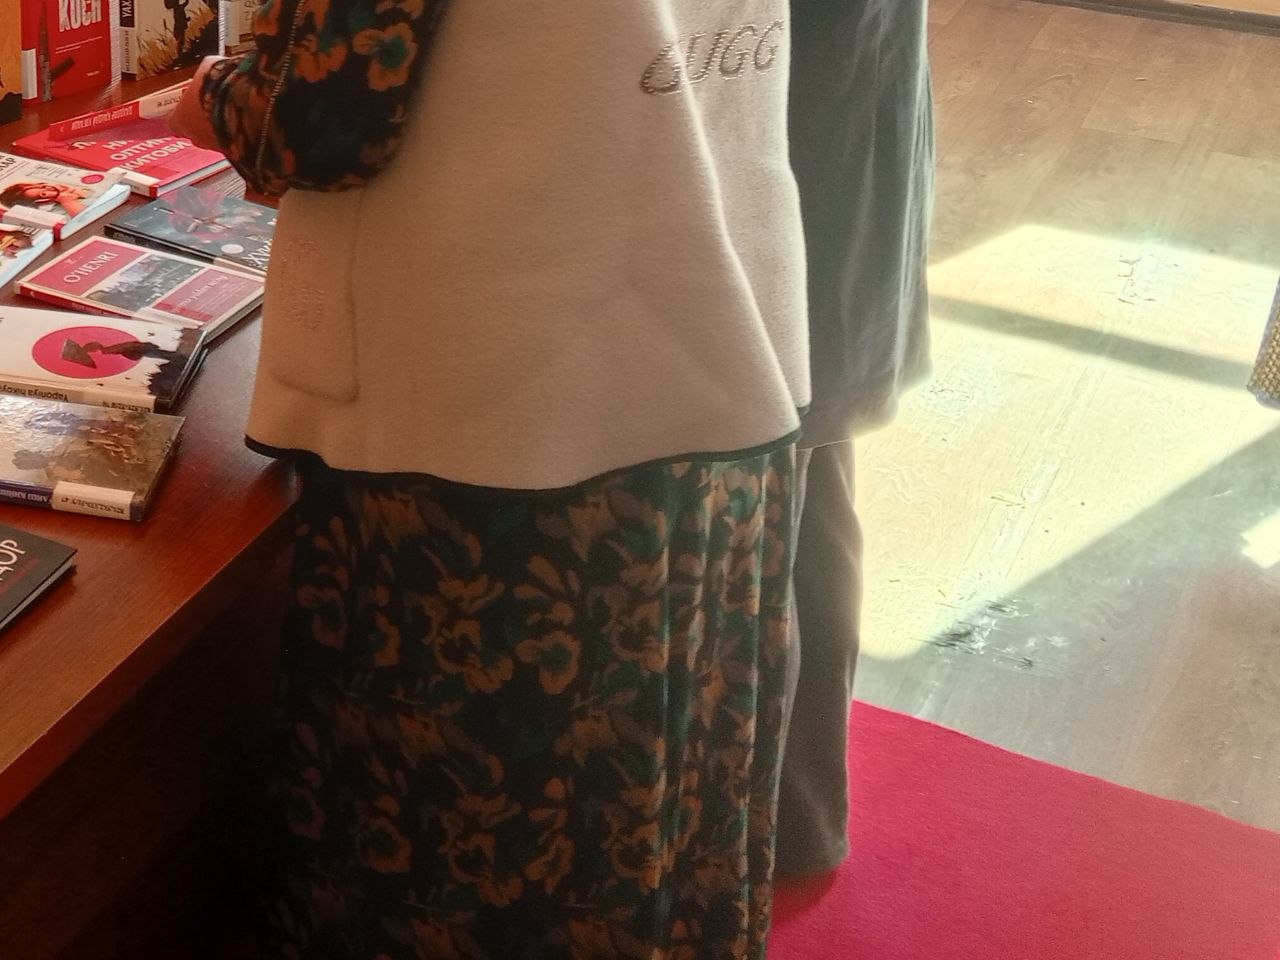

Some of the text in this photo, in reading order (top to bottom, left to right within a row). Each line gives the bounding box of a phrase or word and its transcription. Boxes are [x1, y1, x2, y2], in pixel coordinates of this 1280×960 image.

[121, 141, 192, 170] КИТОБИ
[63, 251, 120, 284] O'HENRI
[27, 387, 69, 402] Yaponiya
